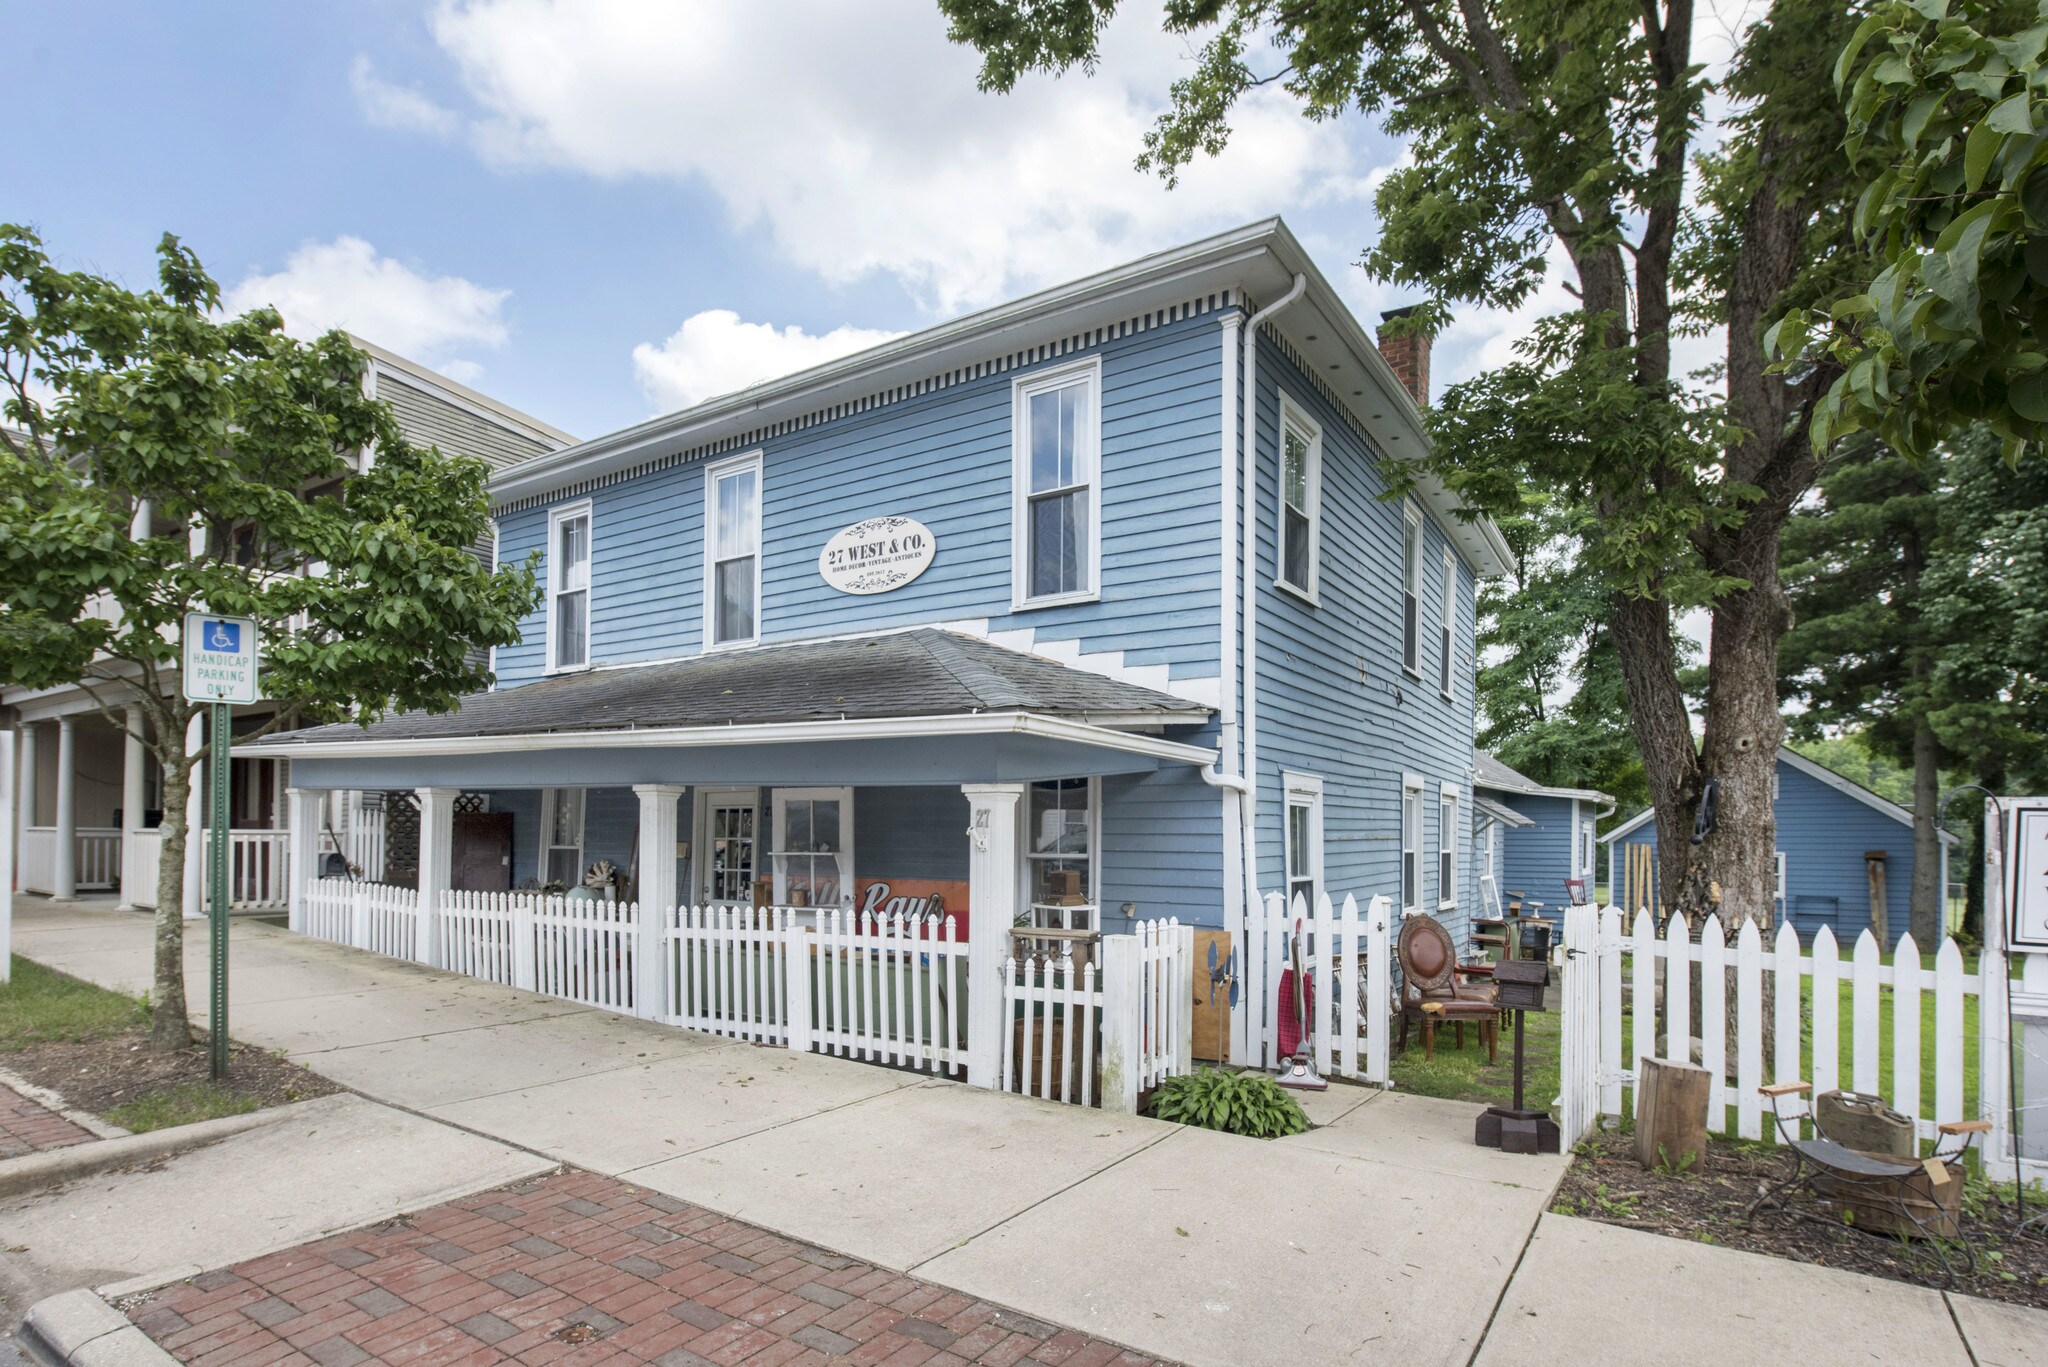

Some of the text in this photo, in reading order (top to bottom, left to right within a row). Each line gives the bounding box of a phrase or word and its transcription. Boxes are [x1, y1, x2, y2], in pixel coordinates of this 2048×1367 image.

[828, 534, 926, 565] 27 WEST & CO.
[832, 552, 922, 573] HOME DECOR VINTAGE ANTIQUES
[193, 653, 249, 667] HANDICAP
[197, 668, 245, 682] PARKING
[207, 683, 235, 696] ONLY
[976, 808, 991, 828] 27
